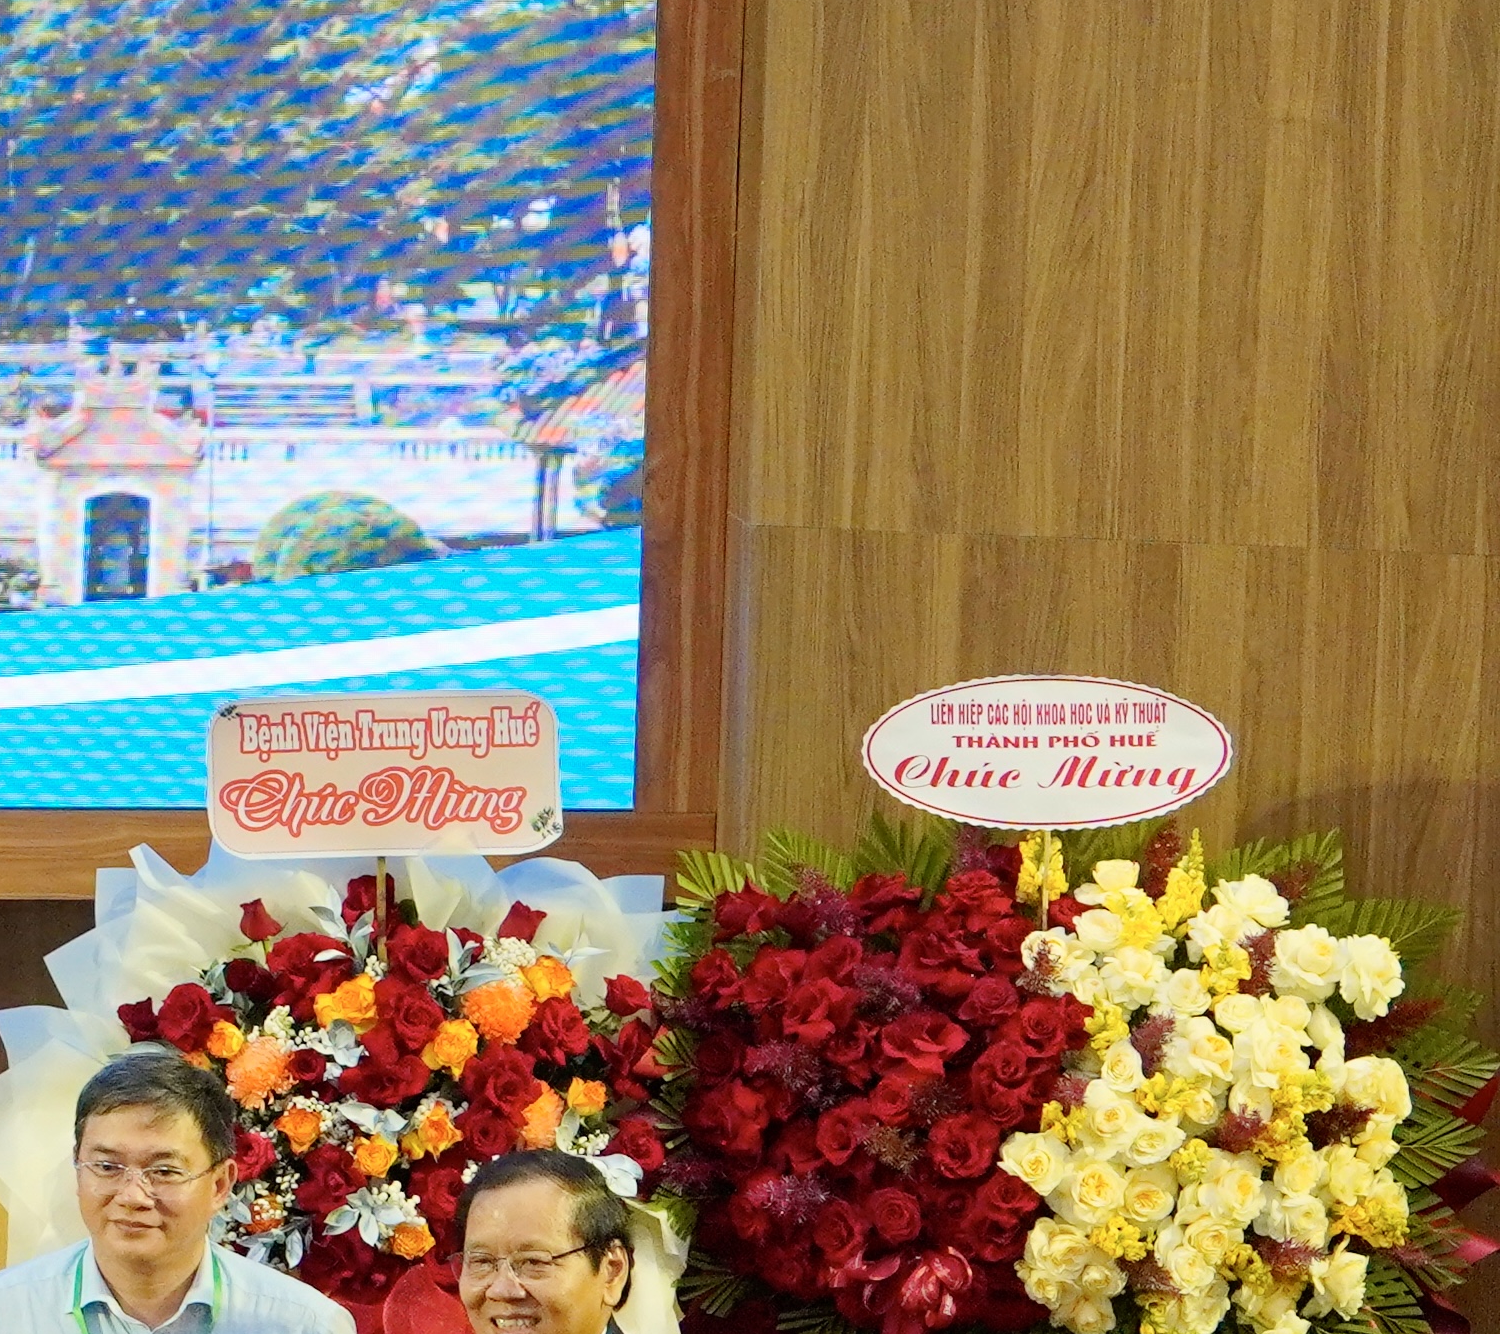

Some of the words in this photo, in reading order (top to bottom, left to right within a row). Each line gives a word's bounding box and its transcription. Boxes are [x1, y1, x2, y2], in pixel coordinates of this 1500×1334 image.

[240, 713, 300, 762] Bệnh
[302, 711, 355, 761] Viện
[357, 709, 427, 760] Trung
[428, 706, 490, 758] Ương
[491, 701, 540, 747] Huế
[930, 700, 954, 725] LIÊN
[958, 700, 983, 730] HIỆP
[987, 700, 1009, 725] CÁC
[1013, 699, 1032, 731] HỘI
[1036, 704, 1066, 725] KHOA
[1071, 703, 1093, 730] HỌC
[1097, 699, 1111, 724] VÀ
[1115, 698, 1129, 724] KỸ
[1133, 698, 1167, 724] THUẬT
[952, 733, 1038, 748] THÀNH
[1048, 731, 1100, 748] PHỐ
[1109, 727, 1160, 747] HUẾ
[894, 754, 1021, 788] Chúc
[1038, 755, 1199, 794] Mừng
[220, 769, 357, 837] Chúc
[359, 766, 527, 834] Mừng
